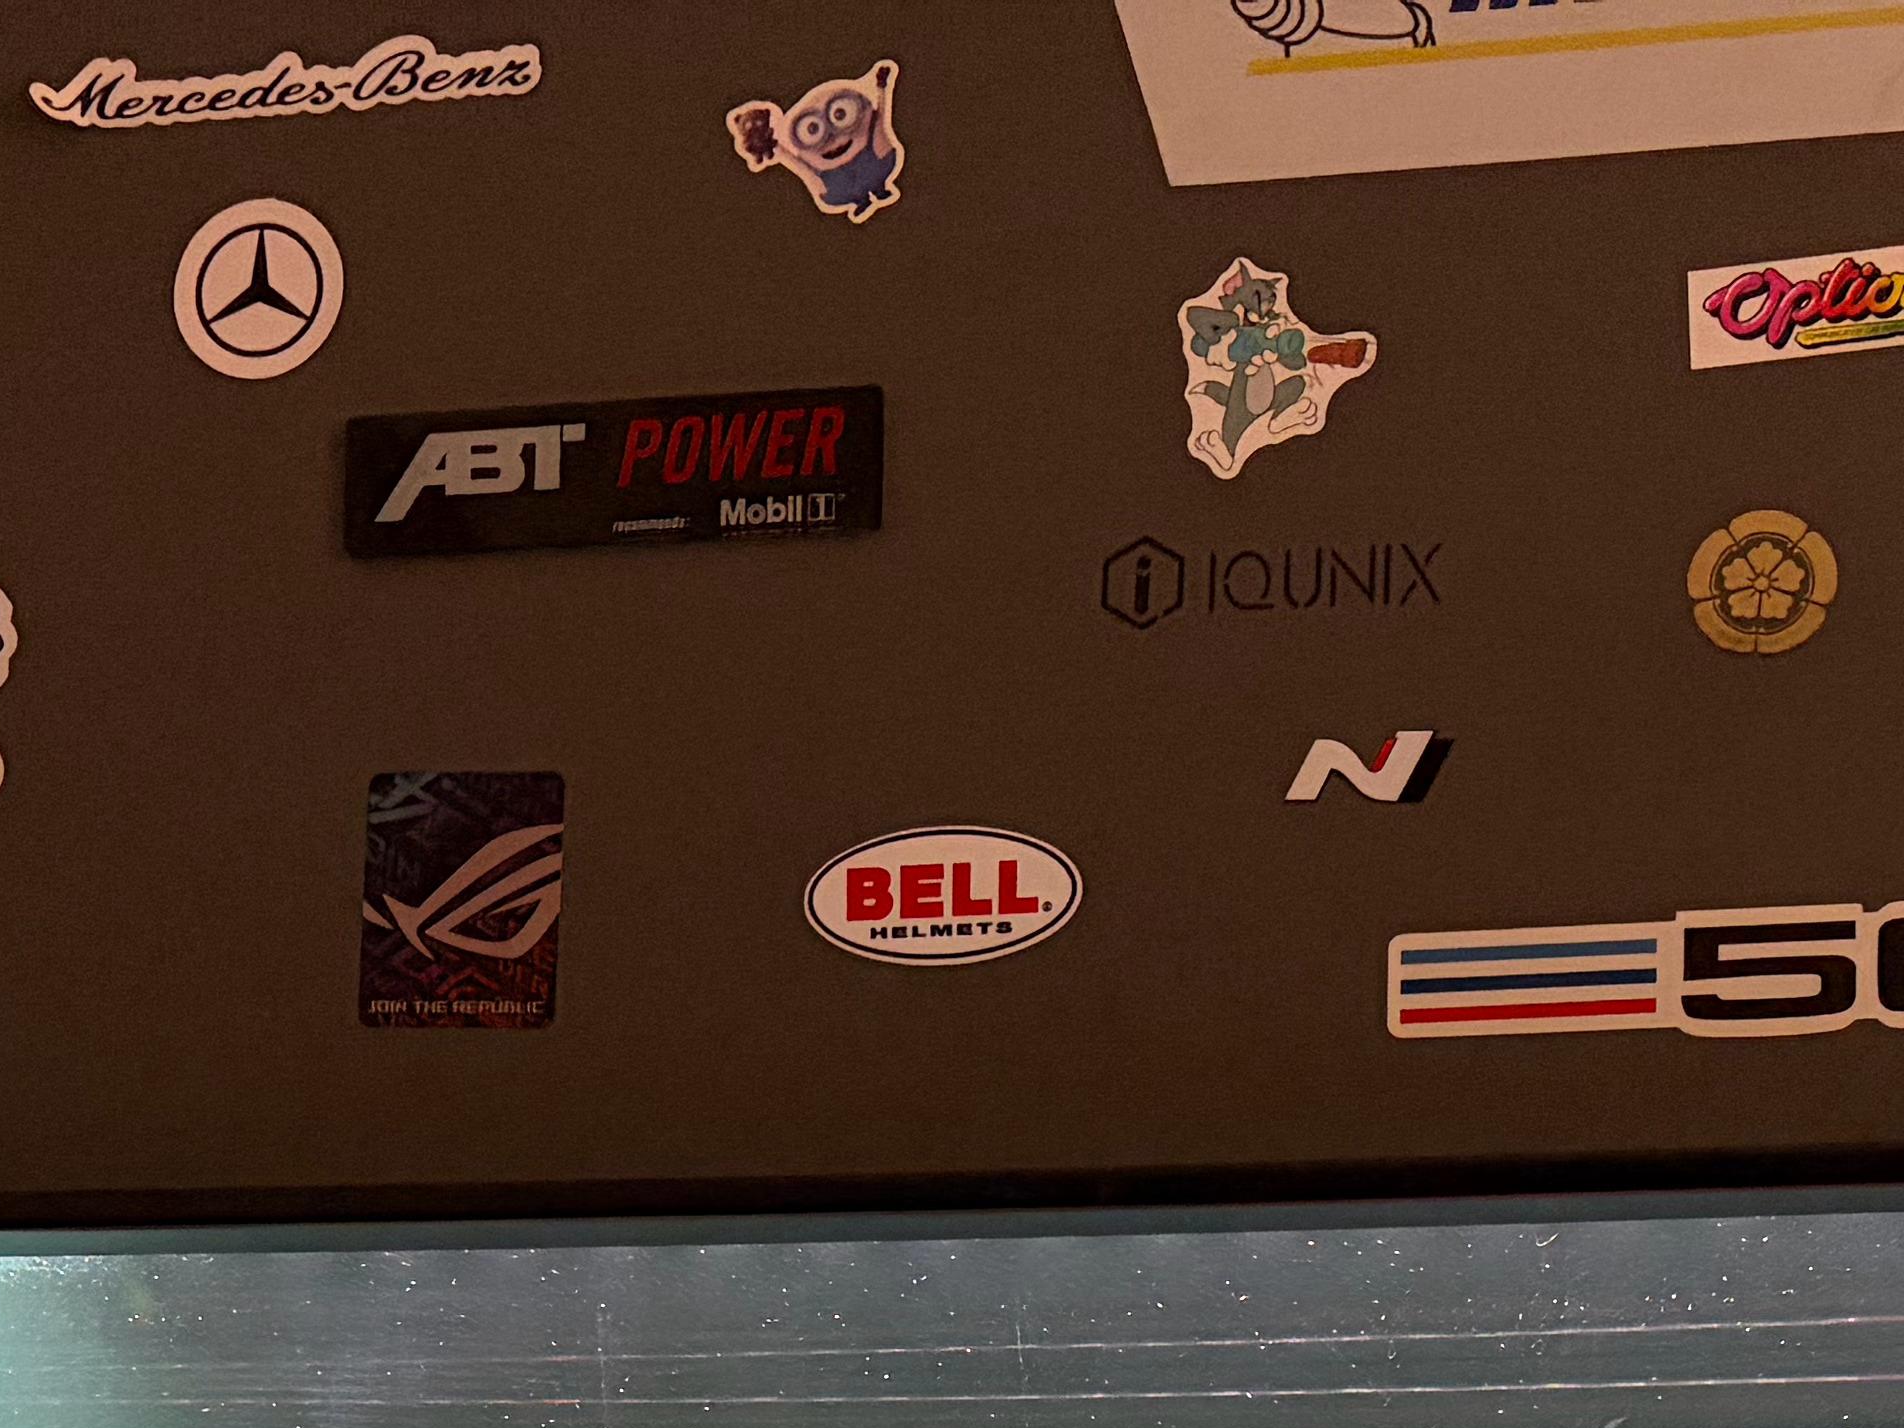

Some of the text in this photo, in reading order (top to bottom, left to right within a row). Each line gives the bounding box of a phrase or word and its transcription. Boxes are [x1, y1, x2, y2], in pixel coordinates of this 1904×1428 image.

[40, 49, 533, 120] Mercedes-Benz
[373, 405, 845, 523] ABT POWER
[719, 494, 803, 527] Mobil
[1208, 542, 1443, 614] IQUNIX
[846, 859, 1040, 922] BELL
[869, 921, 1014, 940] HELMETS
